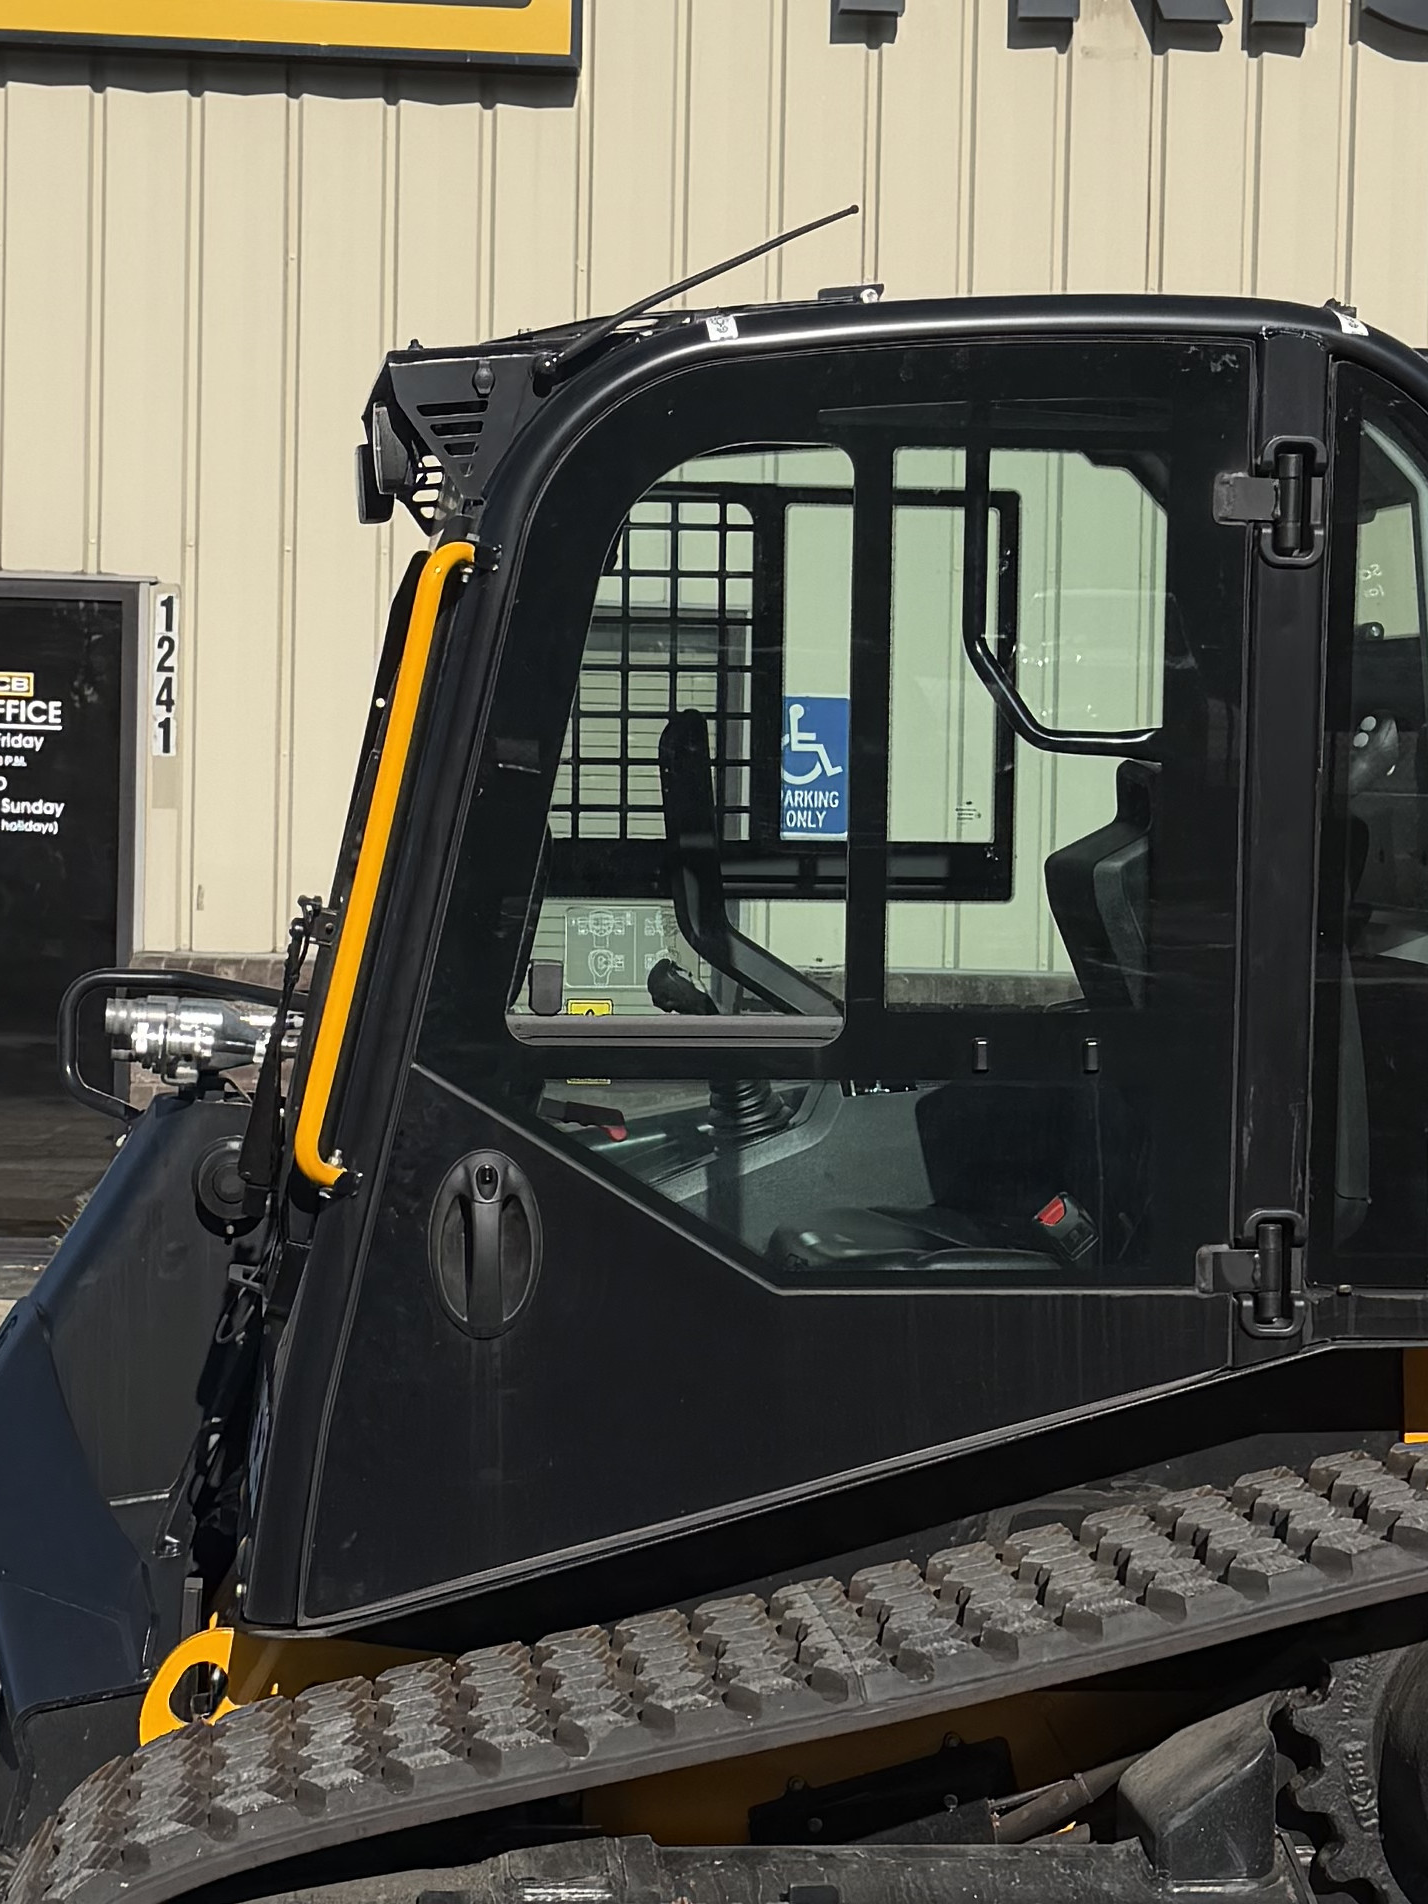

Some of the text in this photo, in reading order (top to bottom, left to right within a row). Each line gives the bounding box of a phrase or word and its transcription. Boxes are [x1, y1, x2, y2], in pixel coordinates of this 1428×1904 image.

[156, 595, 176, 754] 1241
[1, 798, 65, 818] Sunday
[781, 789, 839, 809] ARKING
[1, 819, 59, 835] holidays)
[786, 810, 826, 829] ONLY
